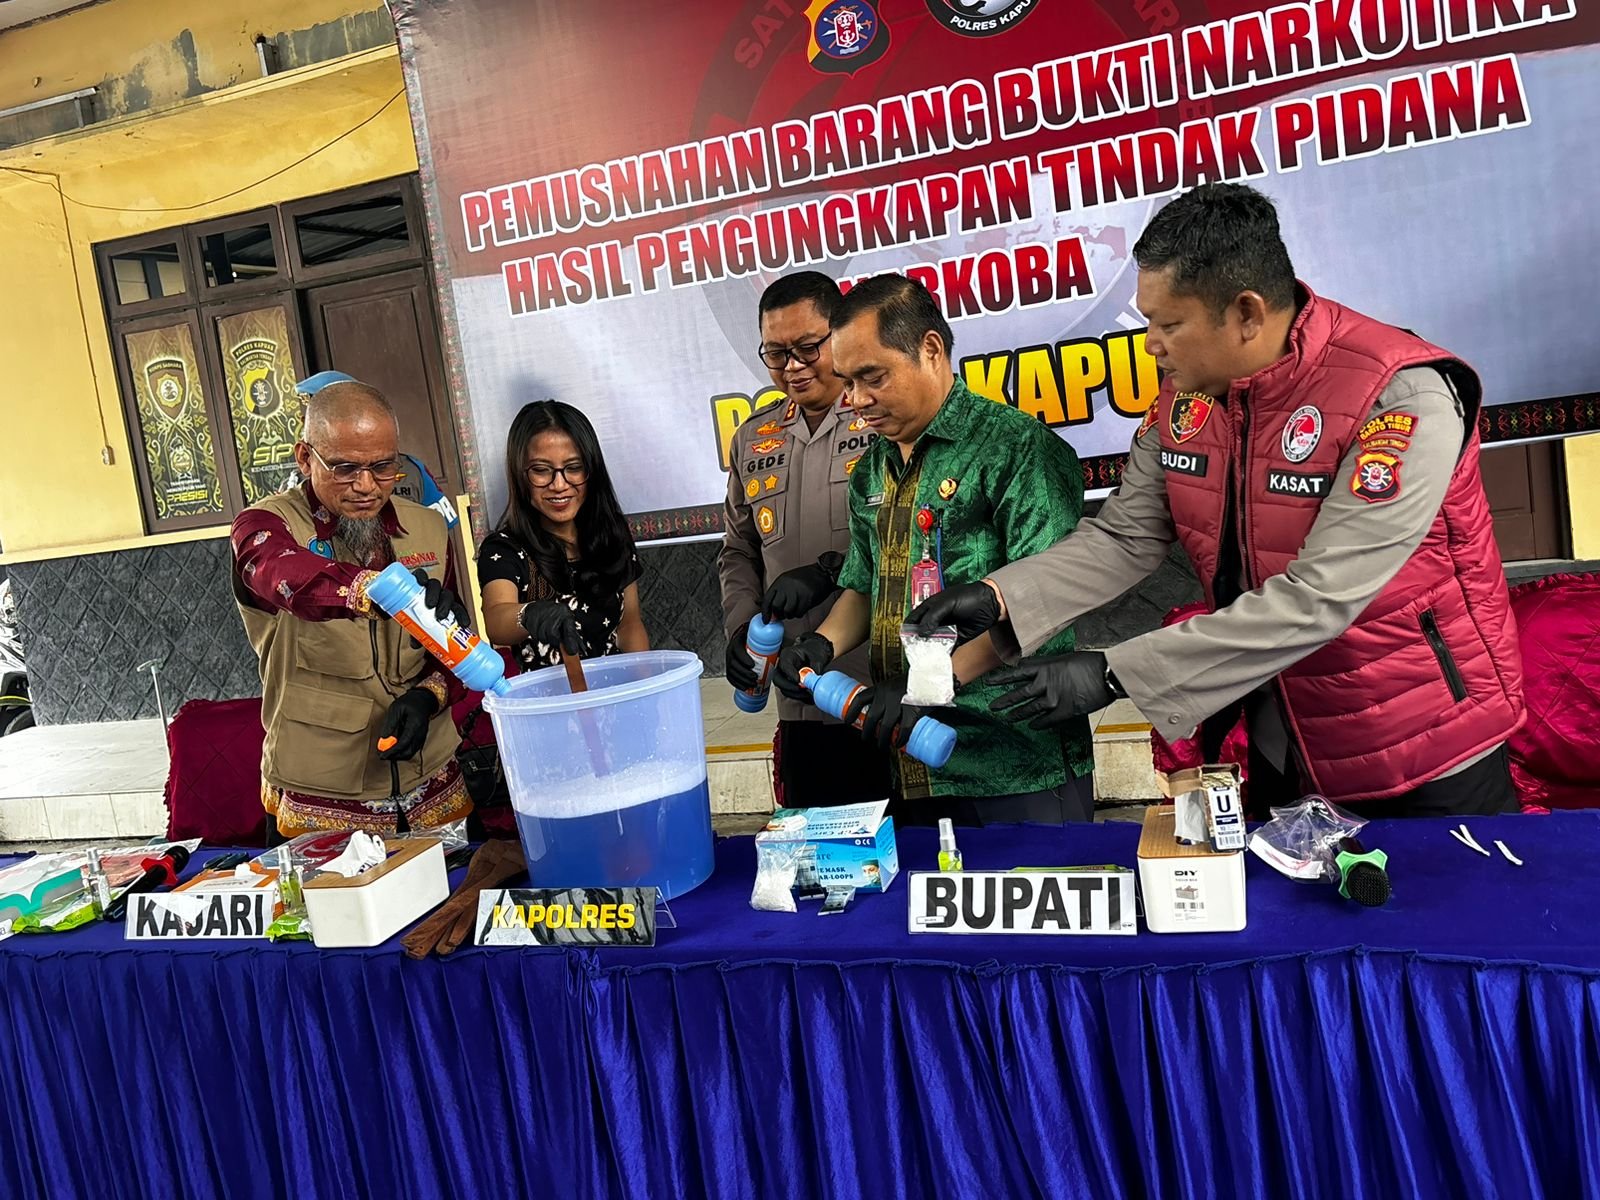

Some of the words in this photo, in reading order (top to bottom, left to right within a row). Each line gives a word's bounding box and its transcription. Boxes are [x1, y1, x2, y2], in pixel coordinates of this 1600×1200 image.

[950, 15, 998, 31] POLRES
[460, 127, 772, 253] PEMUSNAHAN
[771, 79, 992, 187] BARANG
[994, 33, 1180, 141] BUKTI
[501, 240, 634, 318] HASIL
[633, 154, 1037, 295] PENGUNGKAPAN
[1037, 106, 1269, 215] TINDAK
[1273, 52, 1532, 173] PIDANA
[959, 326, 1160, 428] KAPU
[1387, 423, 1412, 433] TIMUR
[747, 453, 786, 473] GEDE
[1161, 451, 1197, 472] BUDI
[1270, 473, 1324, 493] KASAT
[166, 490, 208, 503] PRESISI
[1215, 794, 1232, 814] U
[925, 876, 1122, 930] BUPATI
[491, 902, 637, 930] KAPOLRES
